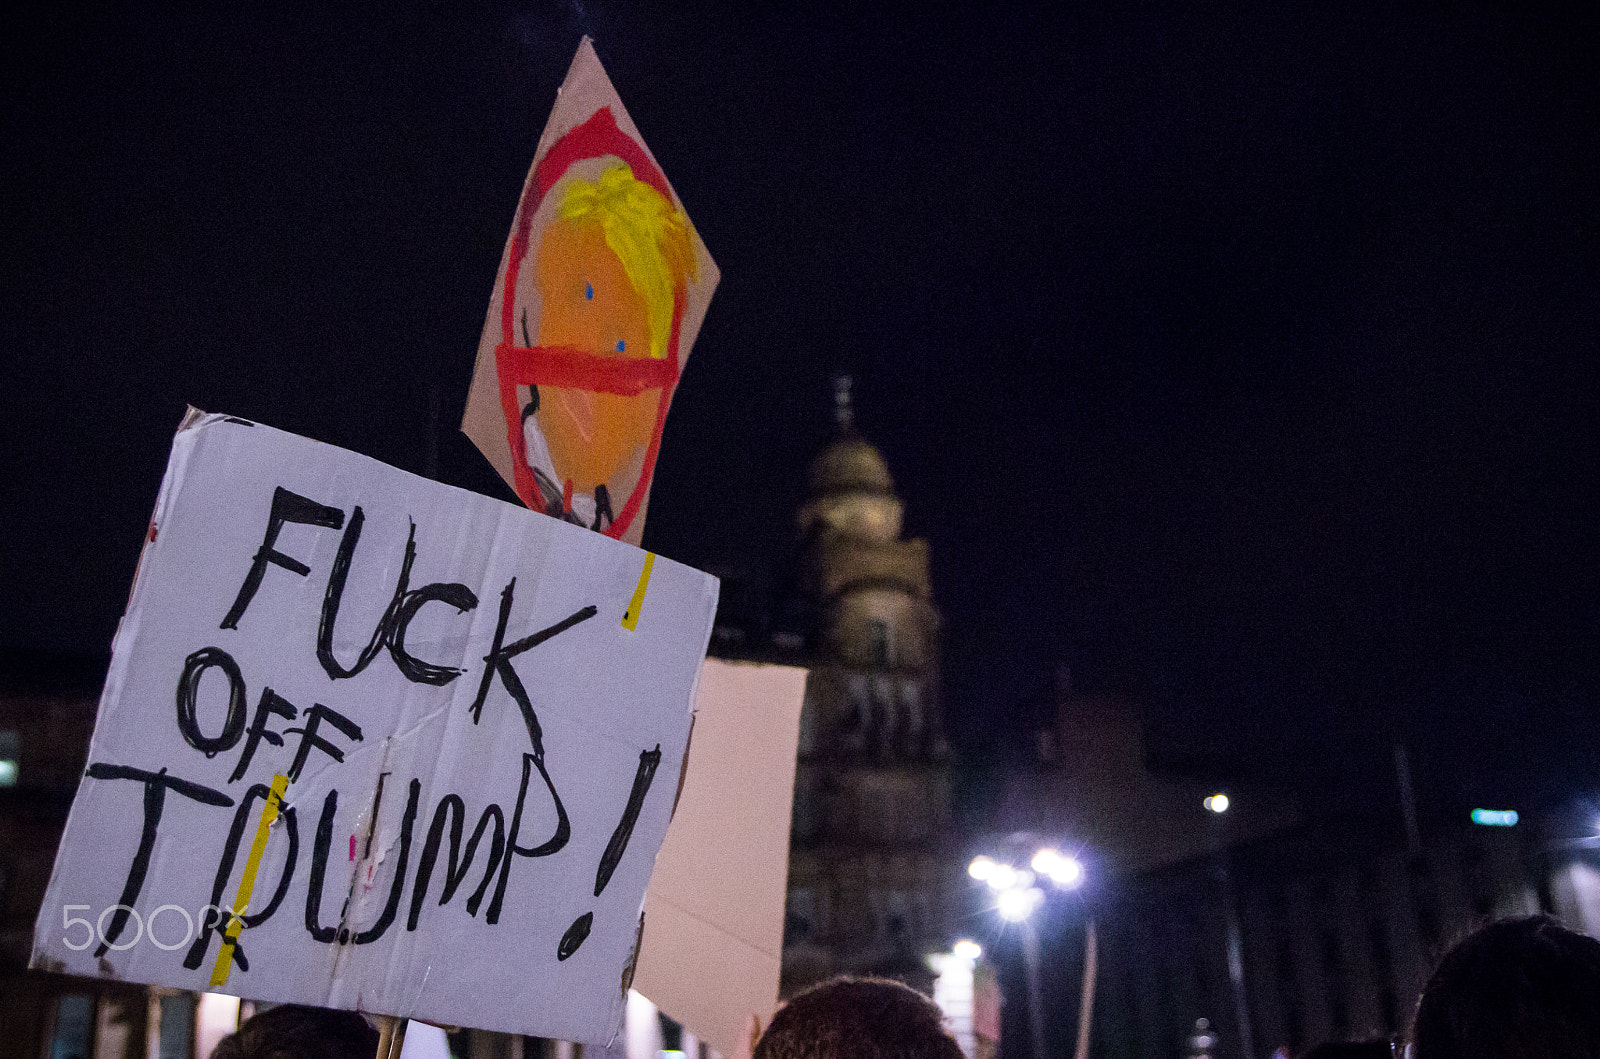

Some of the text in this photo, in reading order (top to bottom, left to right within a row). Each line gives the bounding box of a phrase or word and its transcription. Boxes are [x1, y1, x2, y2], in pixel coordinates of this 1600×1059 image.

[176, 646, 364, 784] OFF
[220, 486, 597, 757] FUCK
[85, 743, 661, 972] TRUMP!
